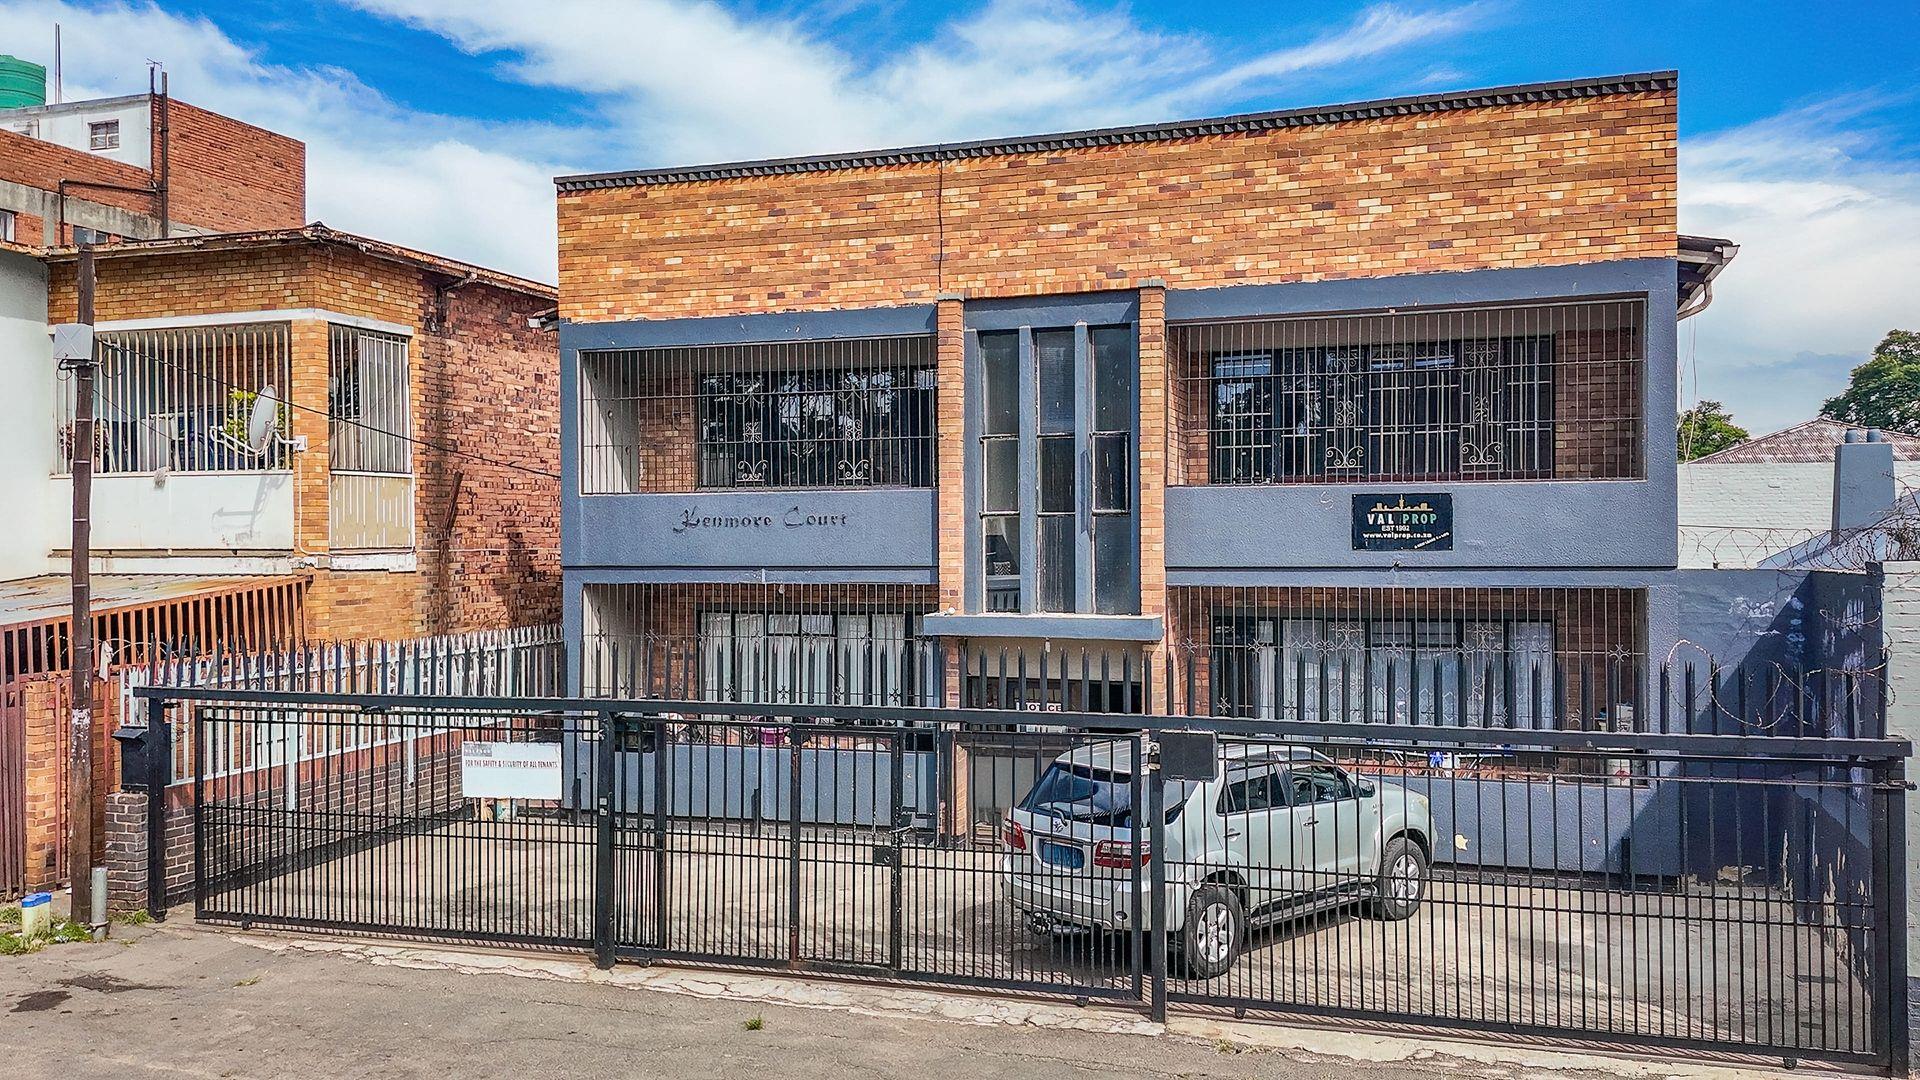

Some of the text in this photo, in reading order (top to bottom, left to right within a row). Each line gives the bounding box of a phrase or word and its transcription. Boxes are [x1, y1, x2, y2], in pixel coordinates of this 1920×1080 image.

[672, 505, 848, 534] Kenmore Court
[1367, 513, 1437, 525] VAL PROP
[1363, 532, 1433, 540] www.valprop.co.za
[1020, 702, 1062, 712] OTCE
[465, 759, 474, 768] FOR
[482, 760, 497, 768] SAFETY
